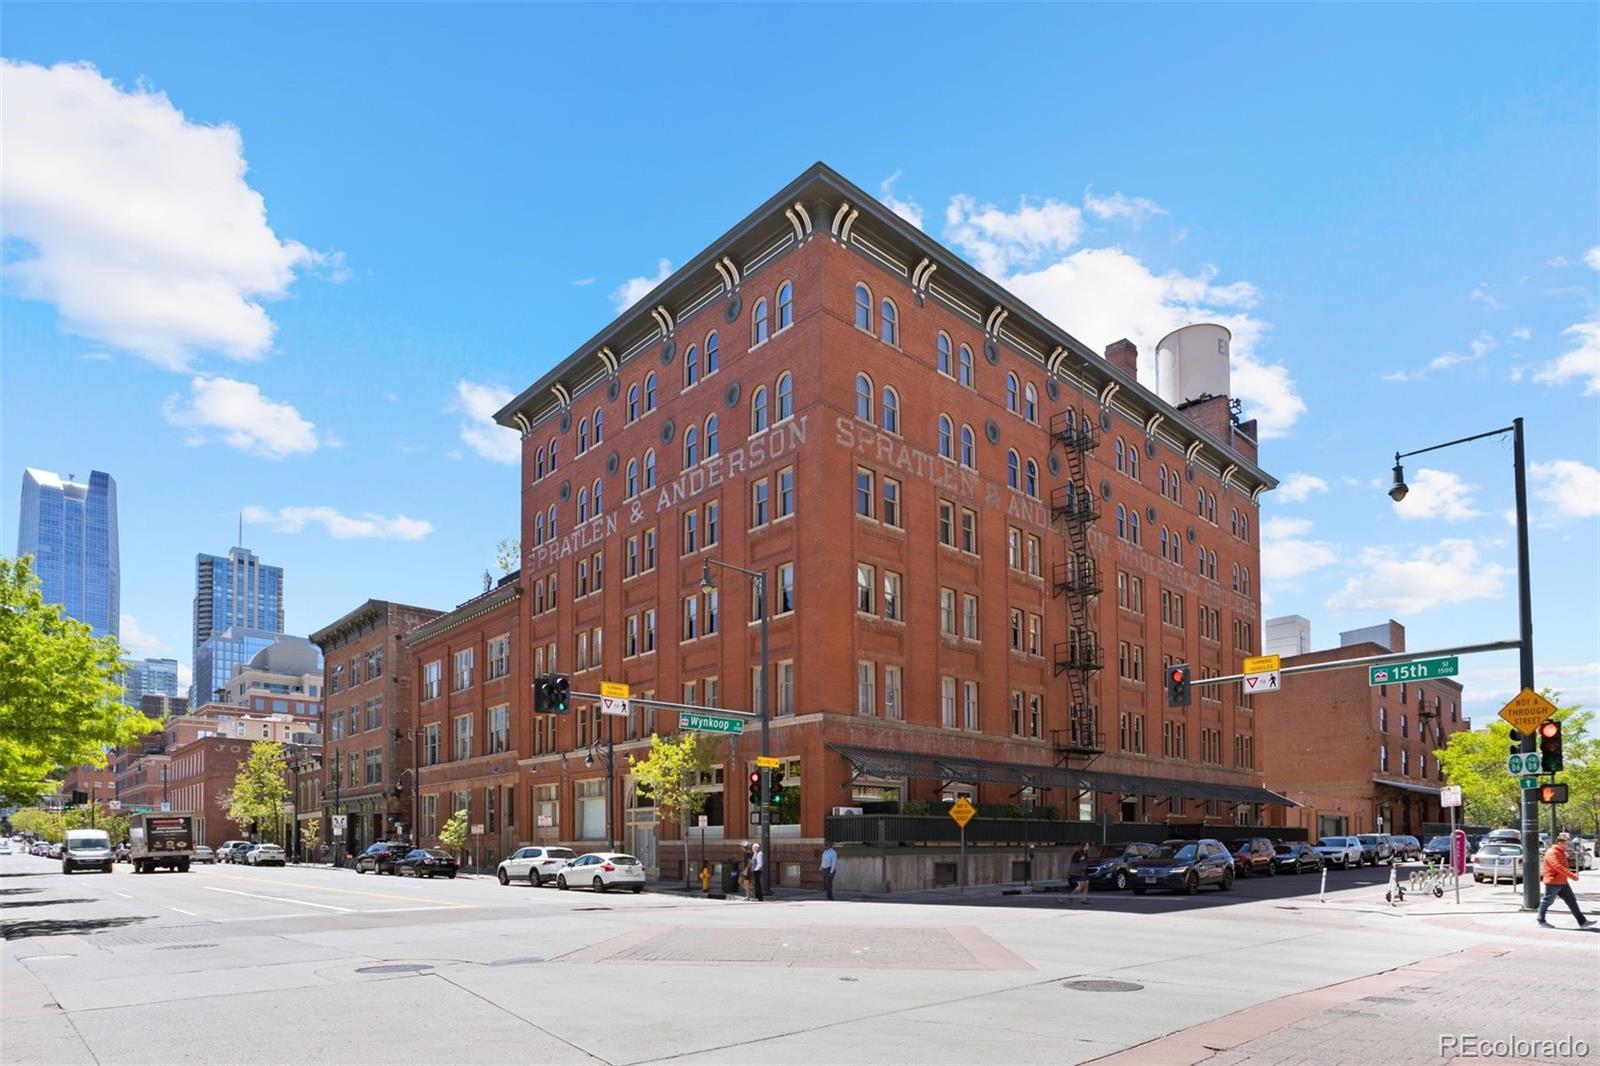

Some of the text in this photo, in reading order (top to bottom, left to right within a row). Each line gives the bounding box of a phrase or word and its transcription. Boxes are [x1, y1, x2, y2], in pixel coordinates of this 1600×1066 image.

[835, 415, 979, 498] SPRATLEN
[526, 415, 808, 574] SPRATLEN & ANDERSON
[1392, 663, 1428, 679] 15th
[1508, 707, 1548, 716] THROUGH
[690, 715, 730, 731] Wynkoop
[1514, 717, 1541, 725] STREET
